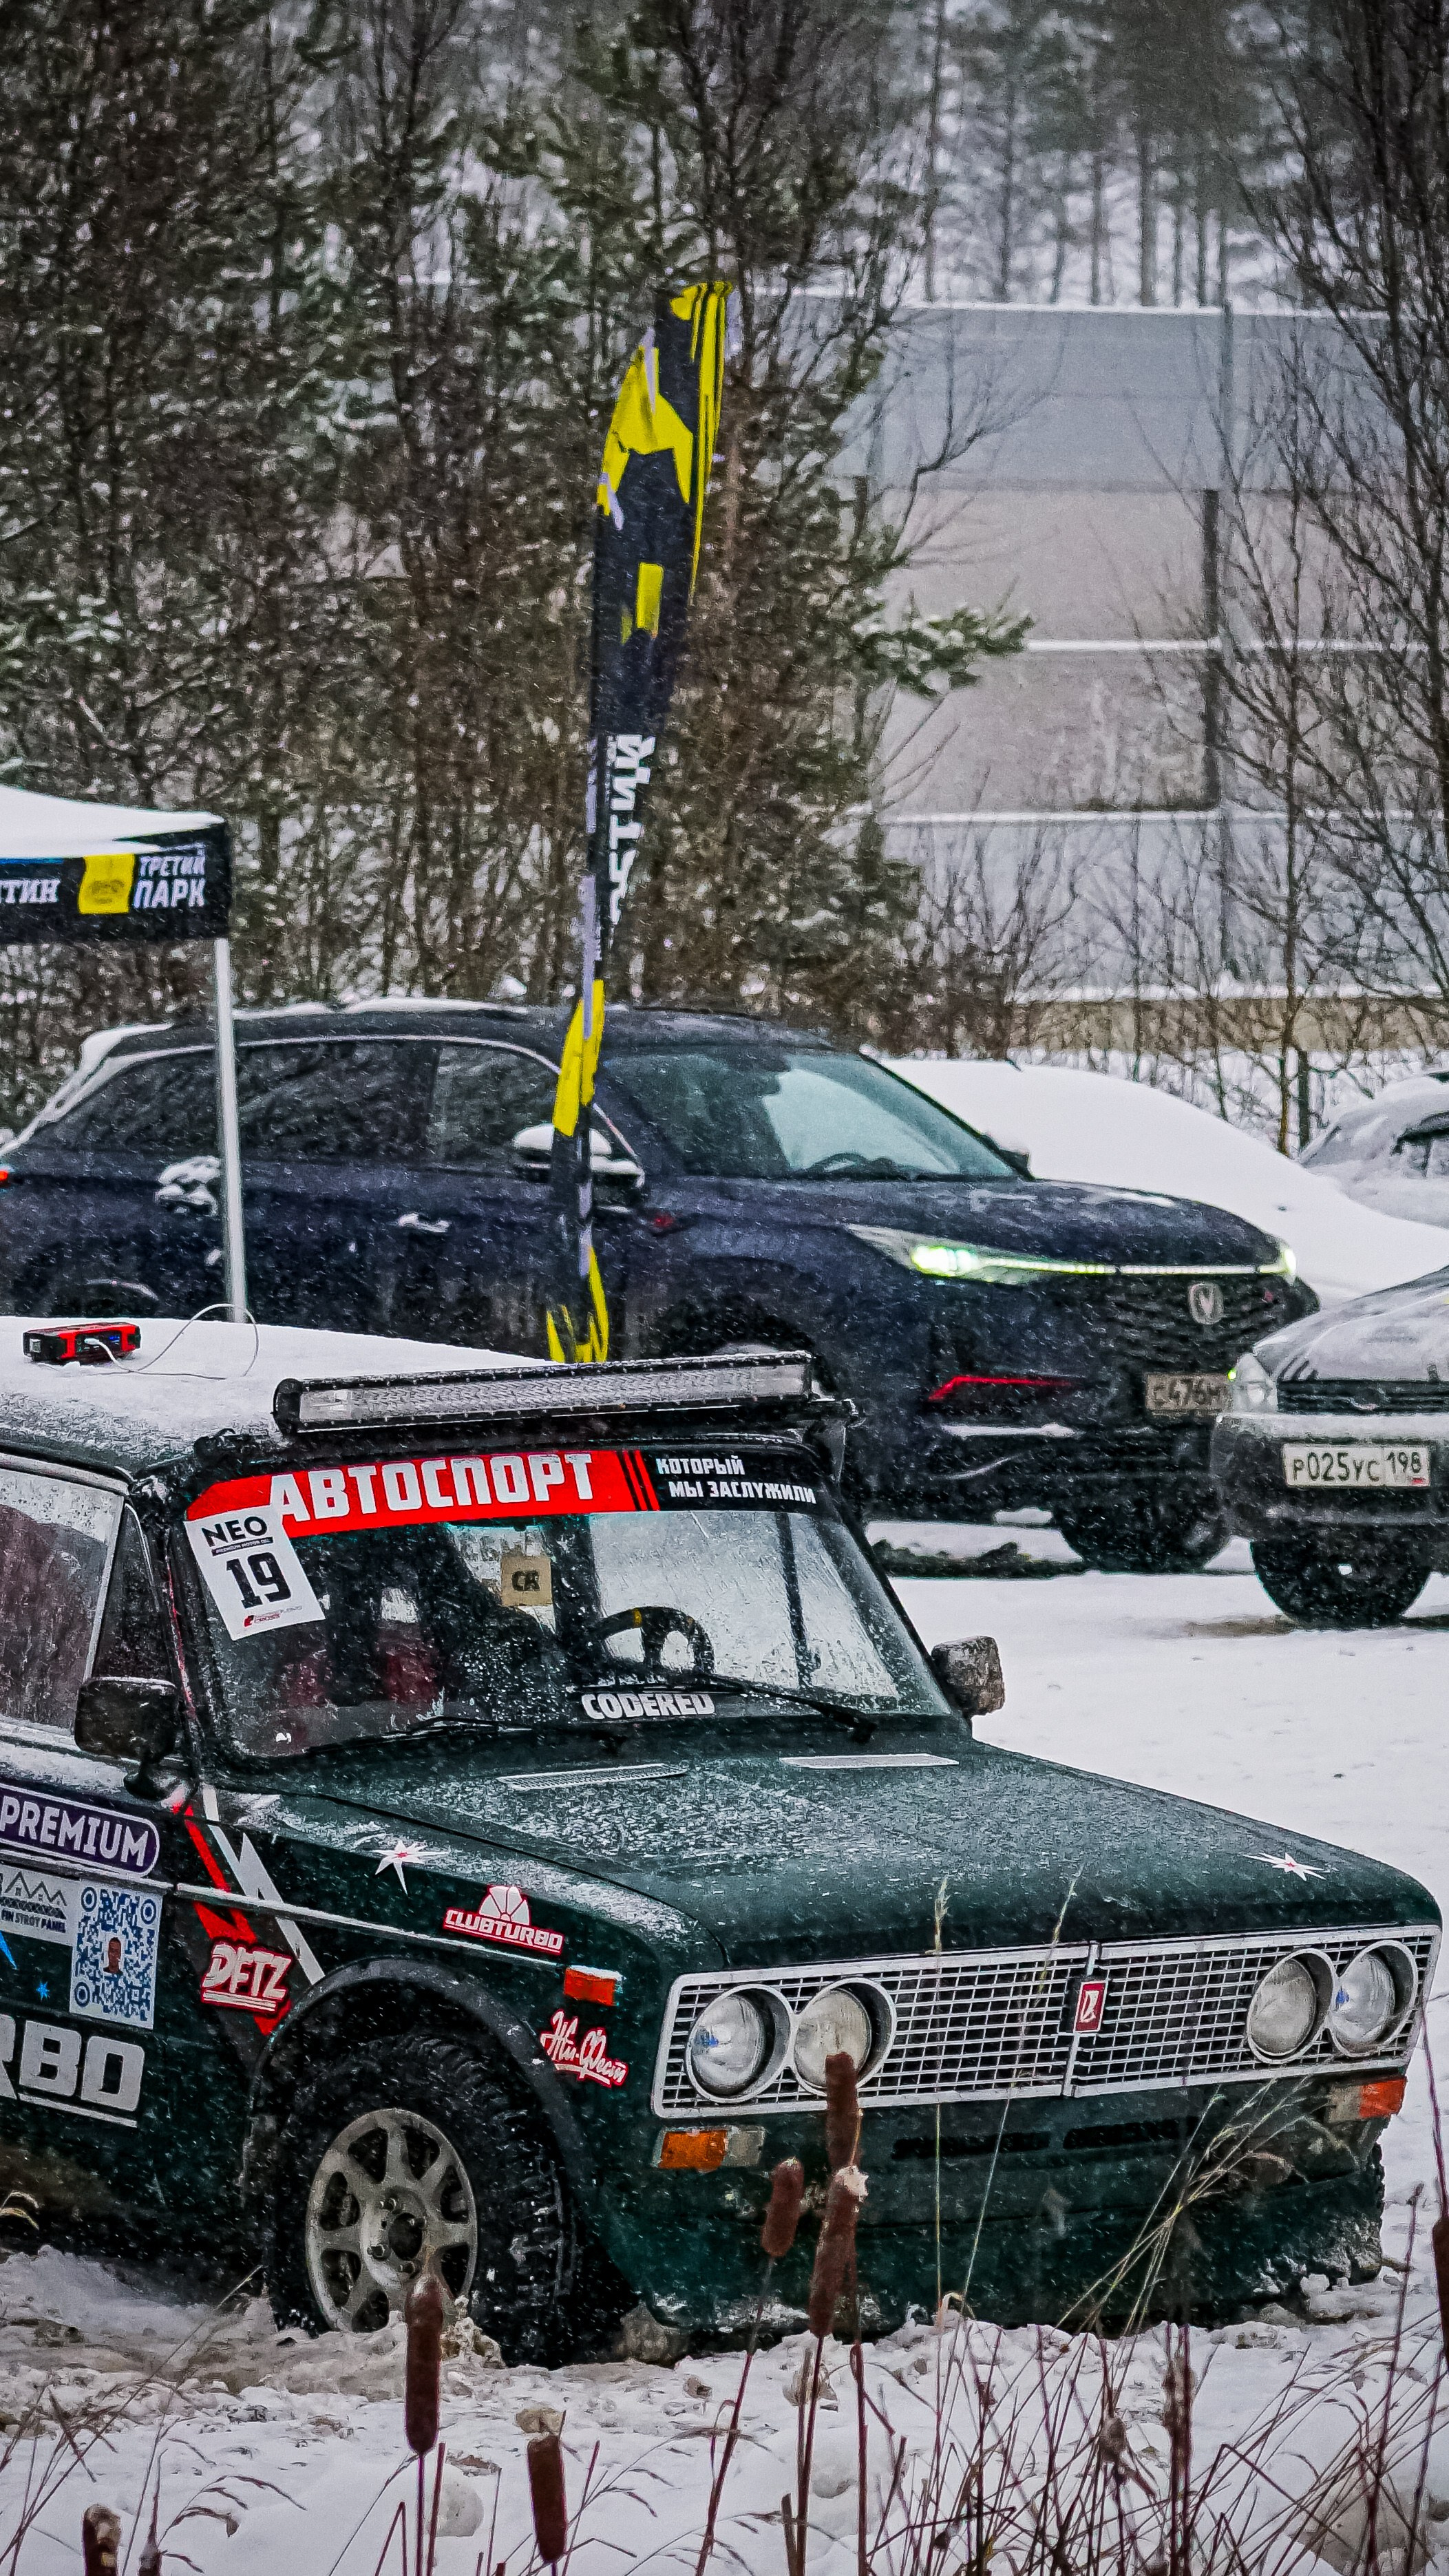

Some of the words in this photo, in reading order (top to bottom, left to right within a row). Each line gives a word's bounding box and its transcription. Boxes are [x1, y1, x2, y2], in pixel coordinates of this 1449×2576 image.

[134, 878, 205, 908] ПАРК
[655, 1455, 745, 1475] КОТОРЫЙ
[269, 1453, 593, 1522] АВТОСПОРТ
[668, 1481, 704, 1497] МЫ
[707, 1481, 816, 1504] ЗАСЛУЖИЛИ
[201, 1516, 267, 1547] NEO
[226, 1552, 291, 1609] 19
[581, 1693, 715, 1720] CODERED
[0, 1795, 149, 1867] PREMIUM
[0, 2014, 145, 2112] BO
